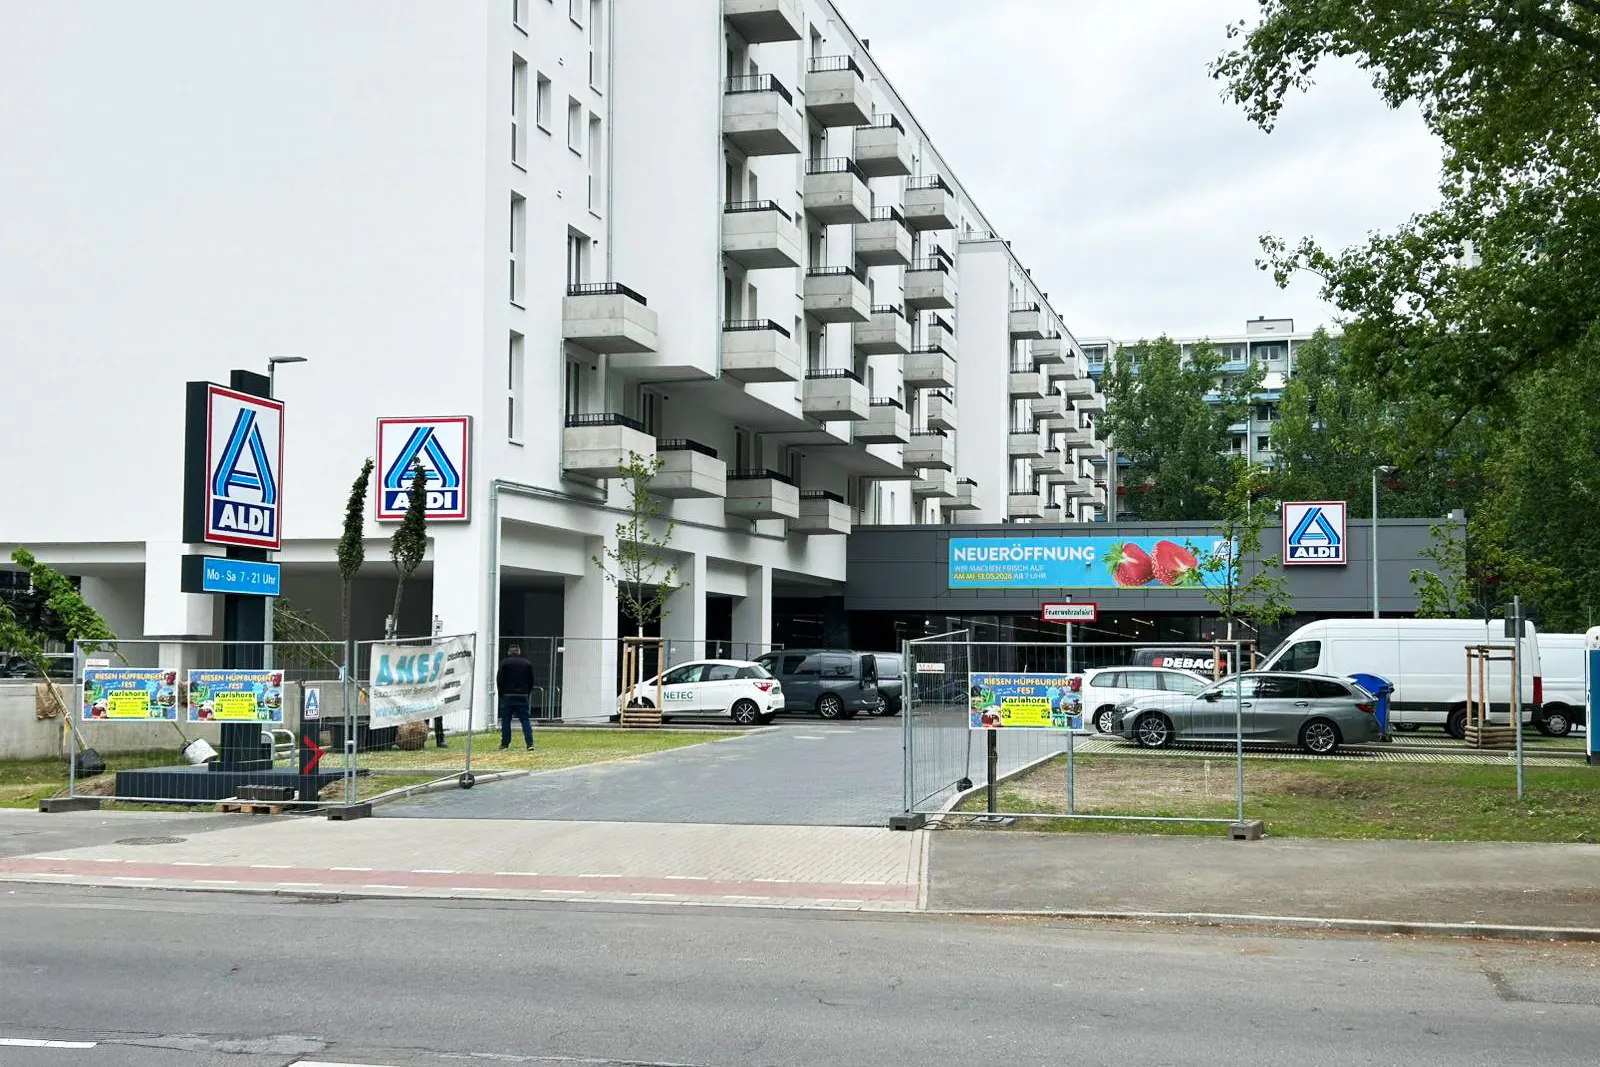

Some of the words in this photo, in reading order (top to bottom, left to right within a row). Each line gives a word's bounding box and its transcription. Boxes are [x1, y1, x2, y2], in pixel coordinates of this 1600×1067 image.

[391, 491, 452, 509] ADI
[218, 503, 270, 534] ALDI
[954, 543, 1095, 562] NEUERÖFFNUNG
[1294, 546, 1336, 558] ALDI
[206, 568, 219, 580] Mo
[226, 570, 236, 581] Sa
[240, 571, 245, 582] 7
[251, 573, 260, 584] 21
[263, 574, 276, 585] Uhr
[1162, 657, 1215, 669] DEBAG
[663, 691, 694, 700] NETEC
